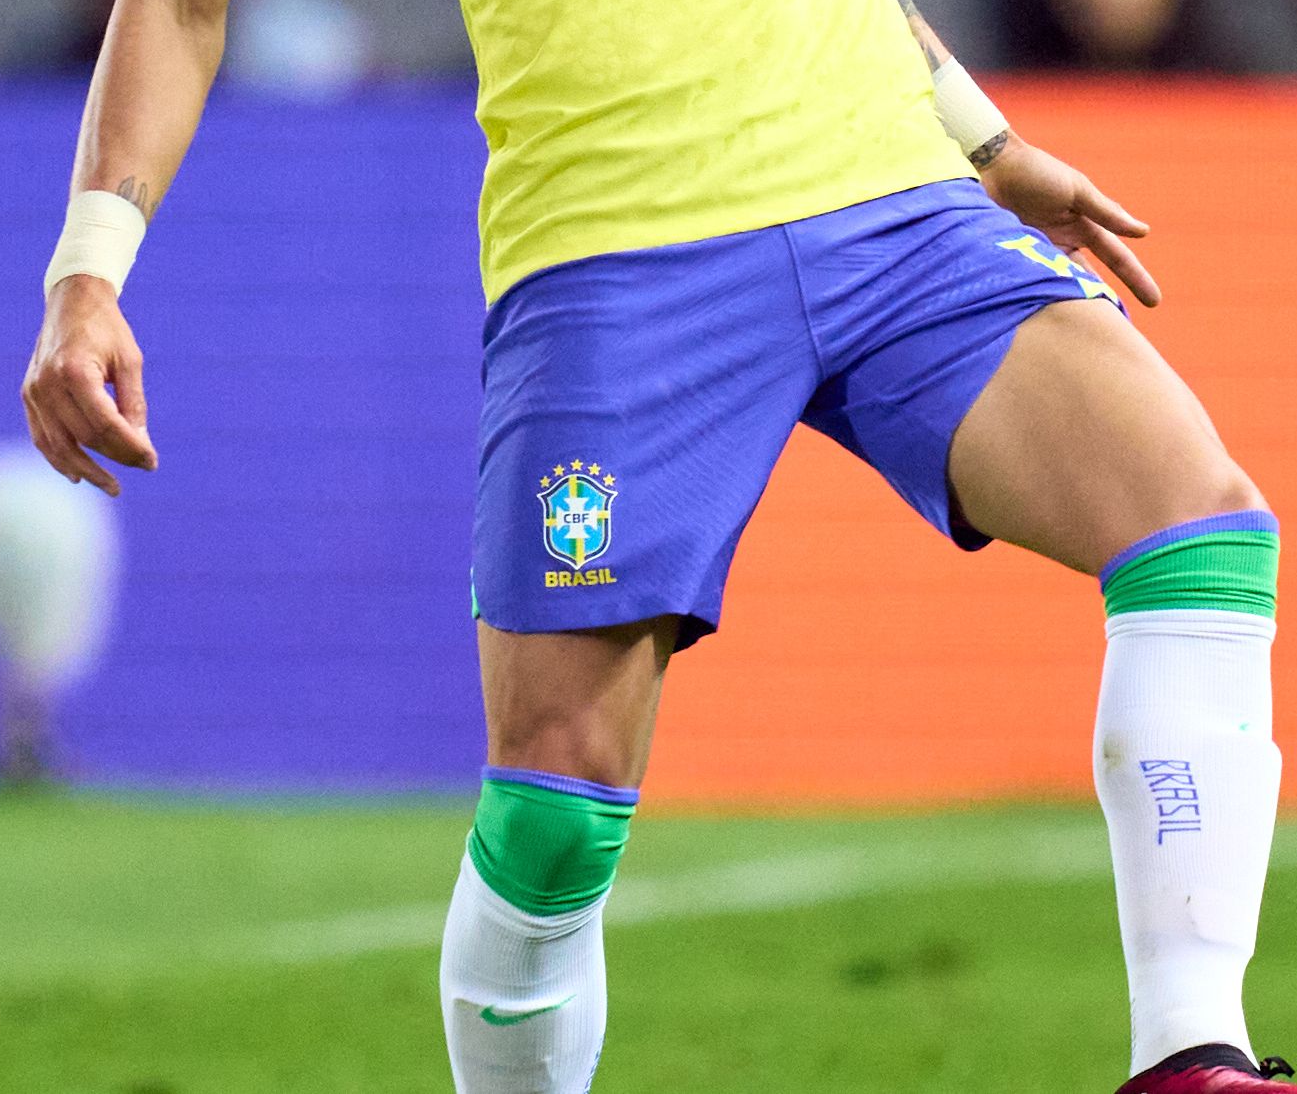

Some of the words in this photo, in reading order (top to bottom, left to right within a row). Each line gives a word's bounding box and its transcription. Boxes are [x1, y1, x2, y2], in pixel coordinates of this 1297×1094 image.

[564, 513, 590, 523] CBF
[545, 568, 617, 587] BRASIL
[1140, 760, 1201, 845] BRASIL
